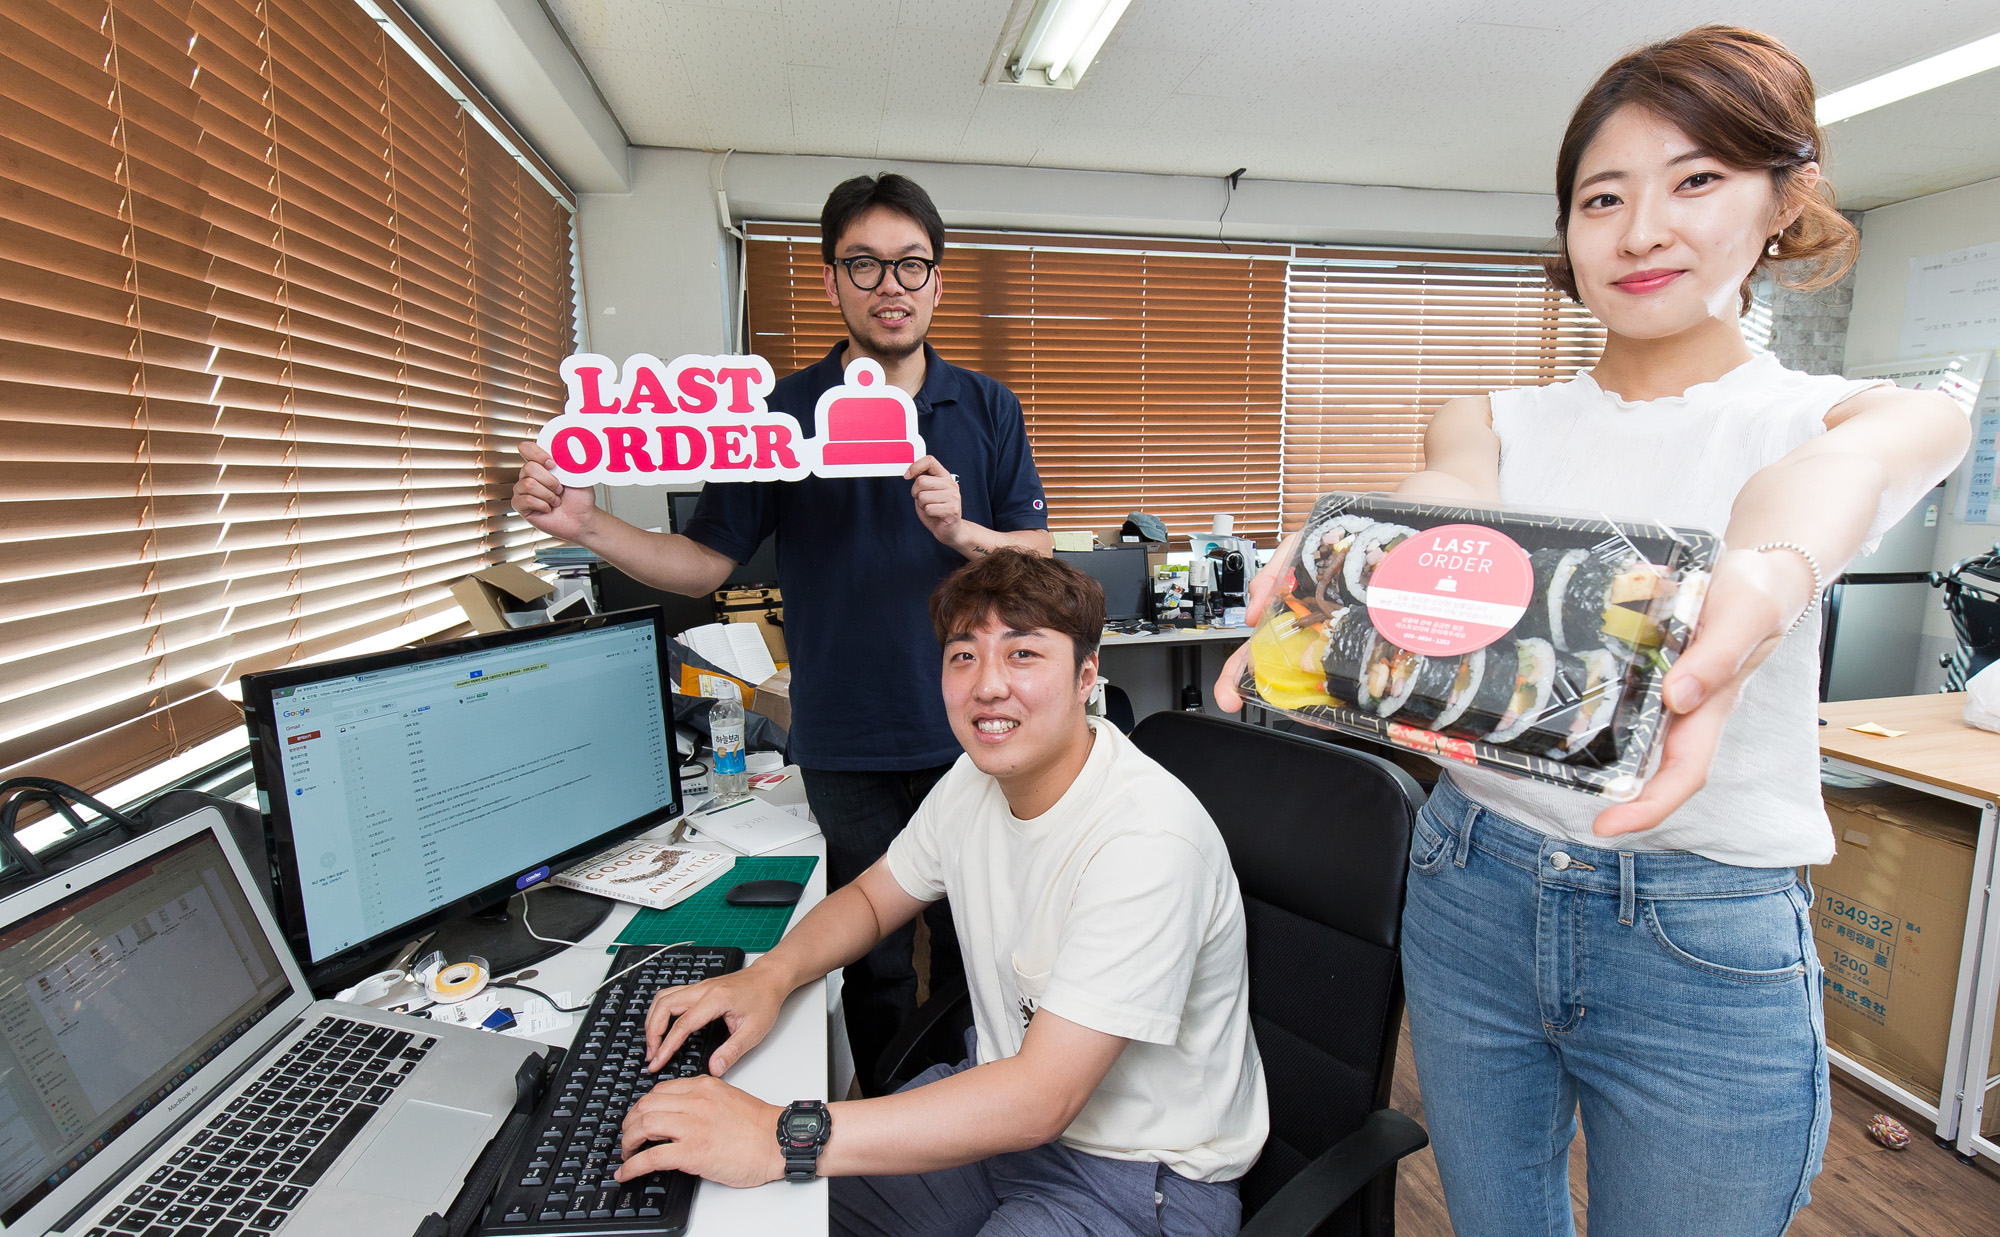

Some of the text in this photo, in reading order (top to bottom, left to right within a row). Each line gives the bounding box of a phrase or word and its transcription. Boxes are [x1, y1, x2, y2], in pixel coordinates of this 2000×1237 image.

[574, 366, 762, 414] LAST
[551, 424, 800, 474] ORDER
[1432, 537, 1491, 556] LAST
[1418, 552, 1493, 574] ORDER
[1401, 617, 1419, 625] 상품에
[1433, 621, 1451, 630] 궁금한
[283, 708, 310, 718] Google
[715, 734, 740, 744] 하늘보리
[585, 844, 665, 881] GOOGLE
[649, 852, 720, 894] ANALYTICS
[1821, 918, 1834, 929] CF
[1826, 897, 1894, 937] 134932
[1833, 951, 1869, 976] 1200
[168, 1085, 199, 1112] MacBook Air
